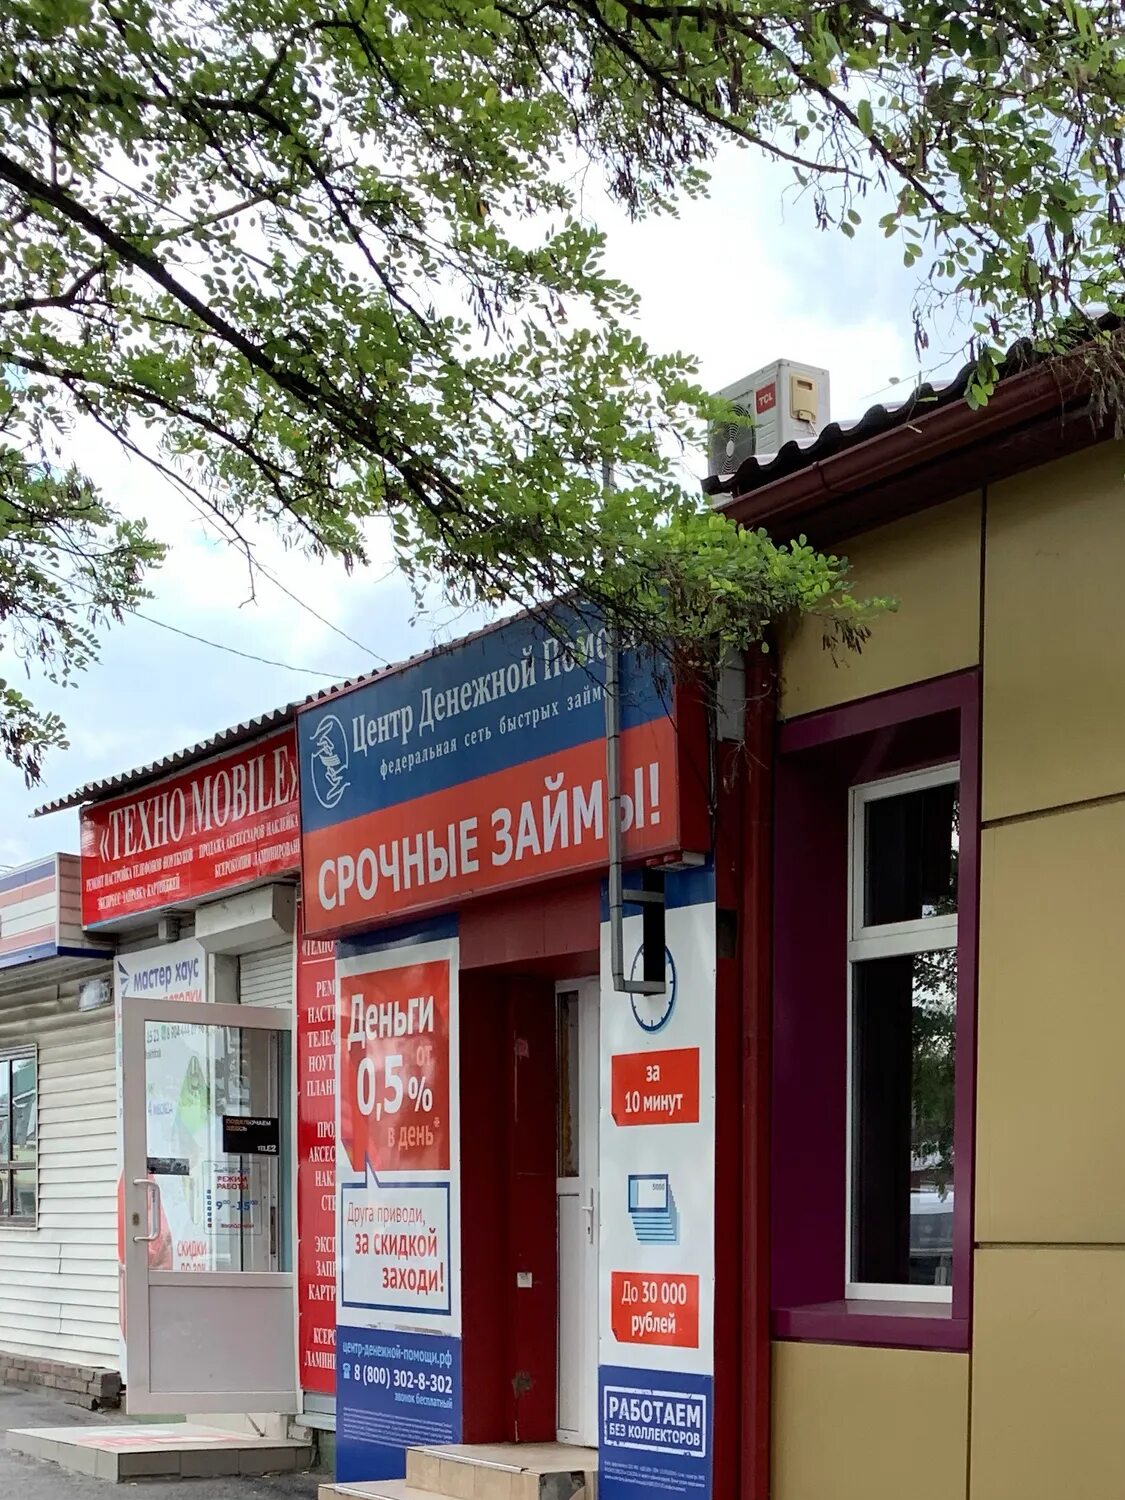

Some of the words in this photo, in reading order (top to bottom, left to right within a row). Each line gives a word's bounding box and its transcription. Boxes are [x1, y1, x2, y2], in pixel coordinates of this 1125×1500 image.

[758, 393, 774, 406] TCL
[353, 706, 414, 756] Центр
[418, 646, 537, 735] Денежной
[543, 628, 608, 681] Помо
[379, 738, 458, 781] федеральная
[463, 727, 493, 747] сеть
[499, 701, 559, 733] быстрых
[318, 816, 480, 910] СРОЧНЫЕ
[134, 965, 172, 992] мастер
[175, 957, 199, 987] хаус
[347, 994, 434, 1050] Деньги
[416, 1046, 433, 1067] от
[645, 1064, 661, 1082] за
[356, 1054, 433, 1122] 0,5%
[625, 1090, 641, 1113] 10
[643, 1092, 683, 1116] минут
[387, 1127, 396, 1148] в
[347, 1202, 374, 1227] Друга
[377, 1206, 426, 1228] приводи,
[355, 1233, 369, 1255] за
[373, 1227, 437, 1260] скидкой
[308, 1283, 336, 1301] КАРТР
[382, 1262, 444, 1295] заходи!
[621, 1280, 638, 1304] До
[641, 1281, 658, 1304] 30
[660, 1282, 687, 1306] 000
[631, 1312, 677, 1337] рублей
[343, 1341, 453, 1368] центр-денежной-помощи.рф
[354, 1364, 361, 1381] 8
[363, 1364, 391, 1390] (800)
[393, 1369, 453, 1394] 302-8-302
[608, 1396, 701, 1429] РАБОТАЕМ
[608, 1422, 626, 1438] БЕЗ
[628, 1425, 701, 1447] КОЛЛЕКТОРОВ
